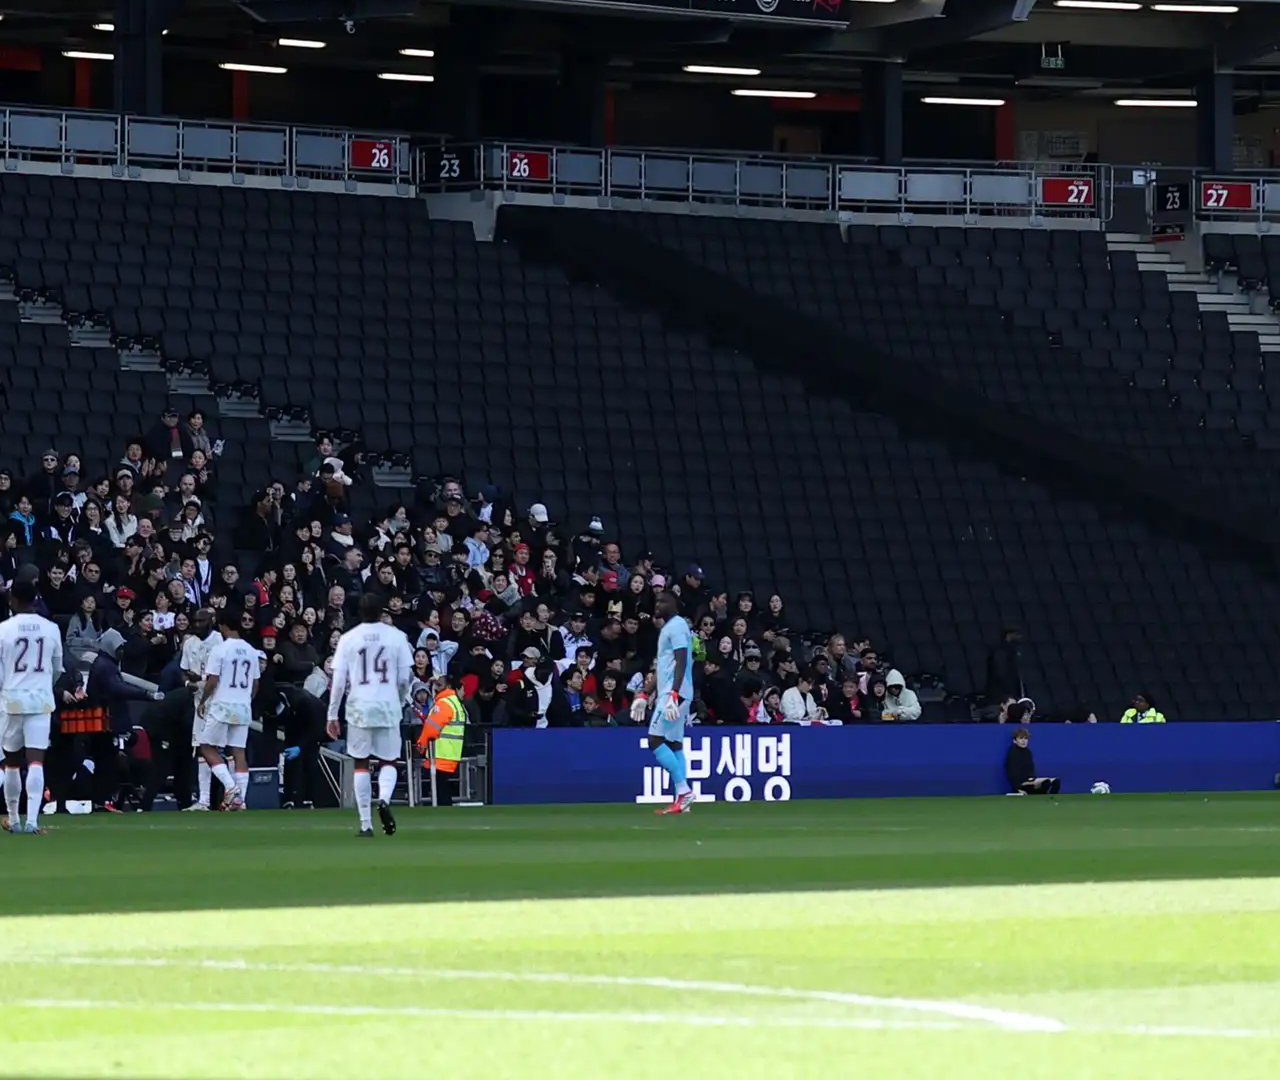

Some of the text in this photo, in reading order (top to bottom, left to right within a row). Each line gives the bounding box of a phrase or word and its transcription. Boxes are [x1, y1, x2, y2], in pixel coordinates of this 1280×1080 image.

[371, 148, 389, 168] 26
[512, 158, 530, 177] 26
[440, 159, 460, 178] 23
[1067, 185, 1090, 203] 27
[1166, 192, 1180, 210] 23
[1206, 189, 1228, 207] 27
[14, 638, 44, 672] 21
[230, 659, 252, 688] 13
[358, 646, 388, 684] 14
